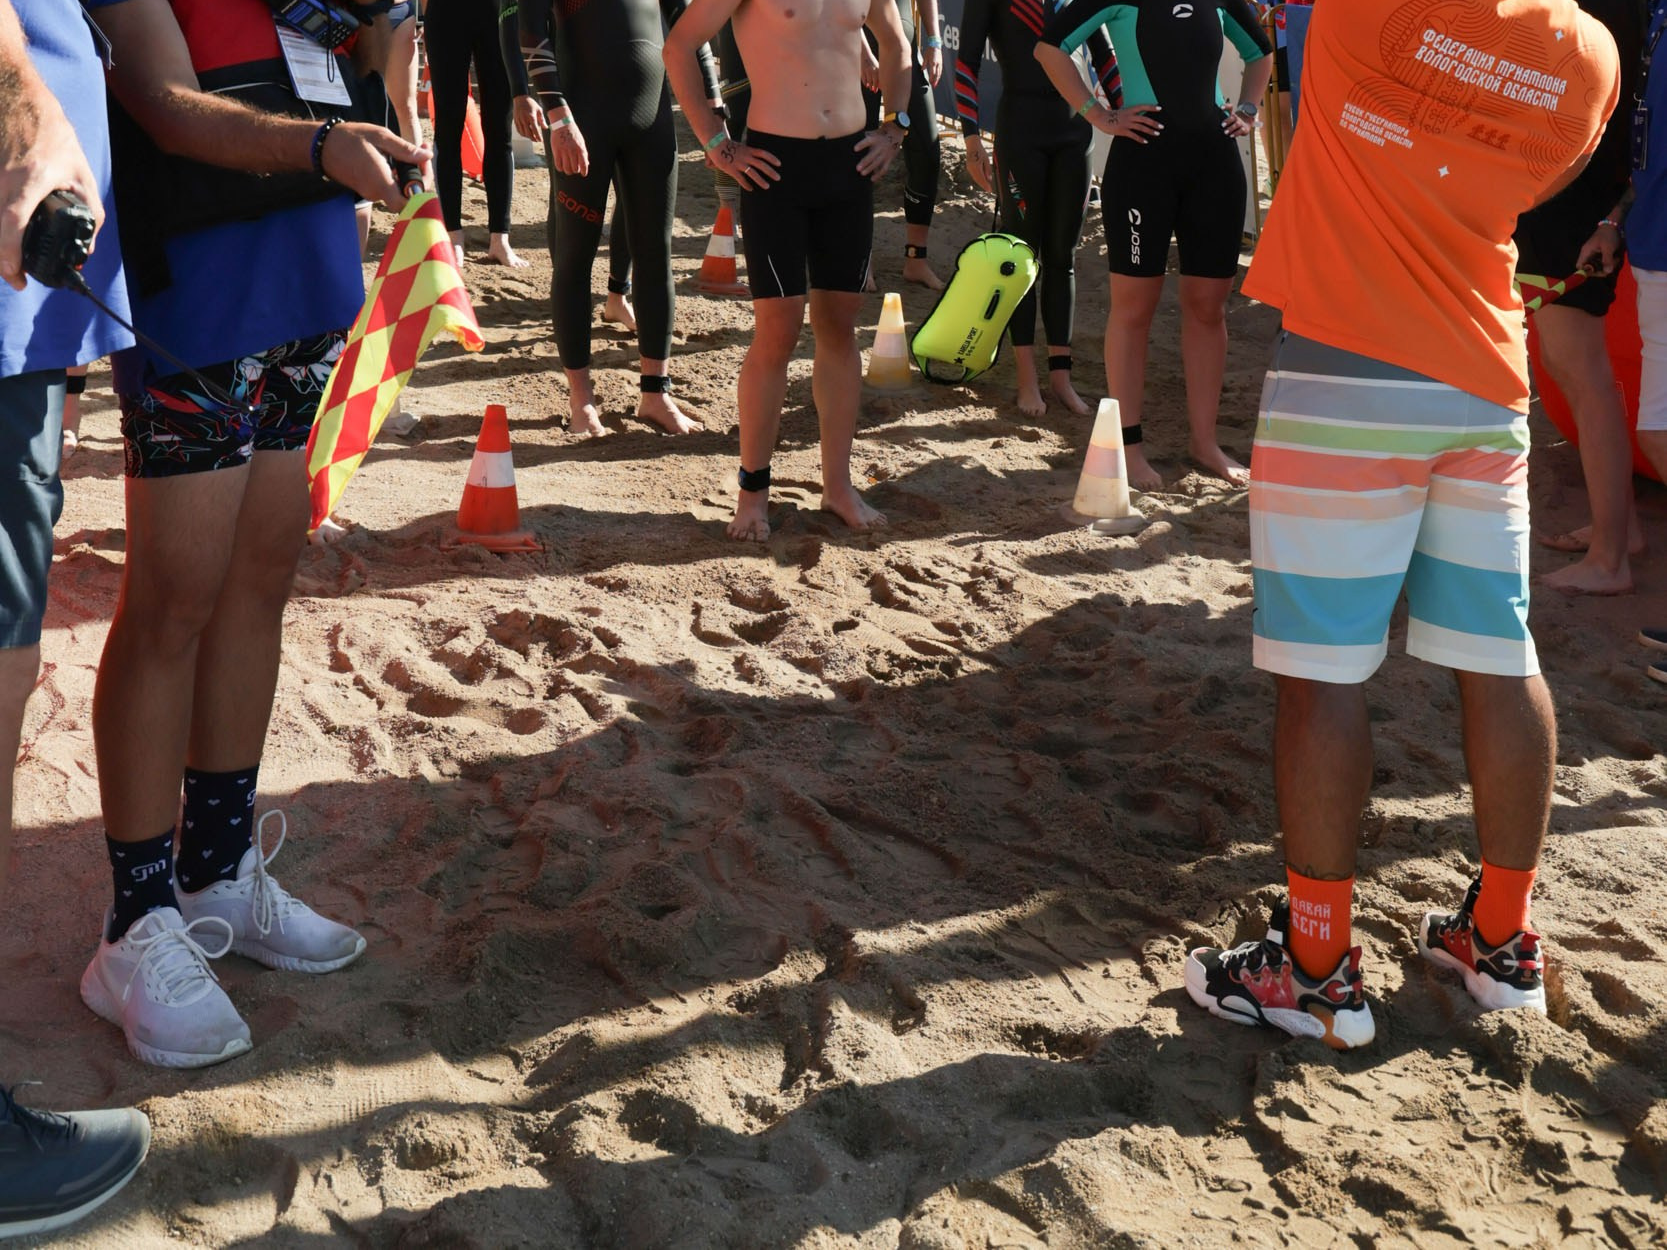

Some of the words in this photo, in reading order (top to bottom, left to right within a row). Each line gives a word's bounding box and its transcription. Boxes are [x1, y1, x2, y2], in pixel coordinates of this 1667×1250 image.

[1415, 46, 1503, 93] ВОЛОГОДСКОЙ
[1503, 81, 1559, 111] ОБЛАСТИ
[1423, 29, 1496, 69] ФЕДЕРАЦИЯ
[1495, 60, 1567, 95] ТРИАТЛОНА
